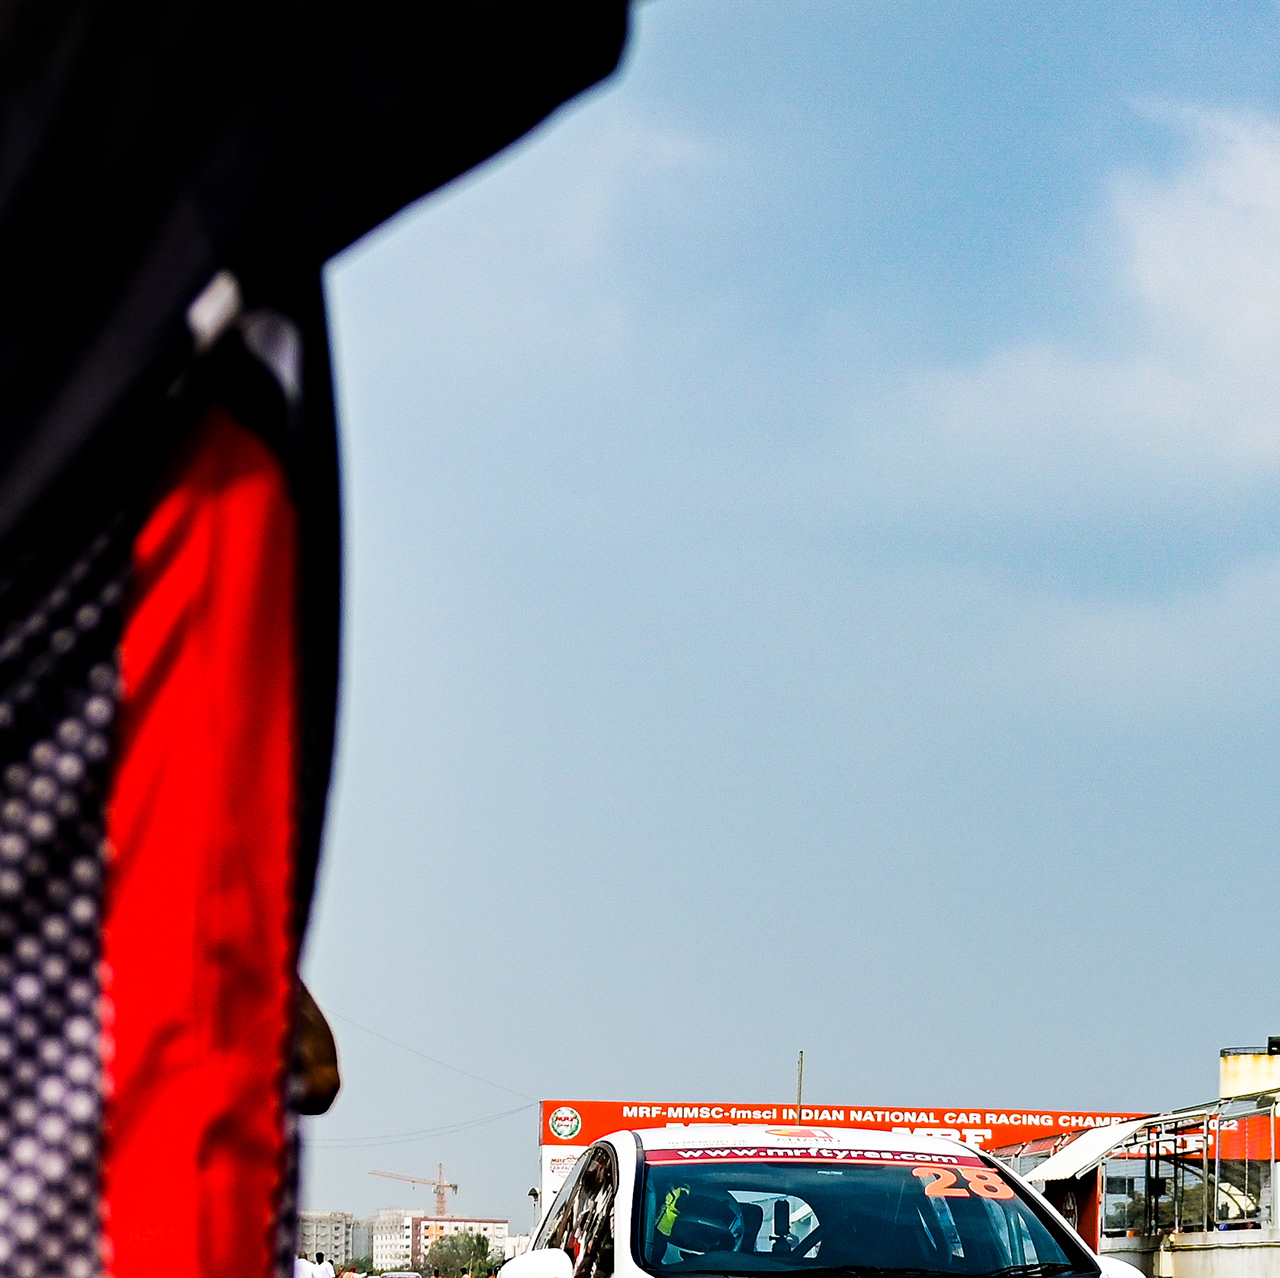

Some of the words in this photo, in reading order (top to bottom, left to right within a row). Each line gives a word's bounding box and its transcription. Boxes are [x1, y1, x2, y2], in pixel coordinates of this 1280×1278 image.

[782, 1108, 845, 1121] INDIAN
[850, 1110, 940, 1123] NATIONAL
[944, 1111, 981, 1124] CAR
[985, 1112, 1054, 1126] RACING
[676, 1147, 959, 1164] www.mrftyres.com
[911, 1166, 1016, 1200] 28
